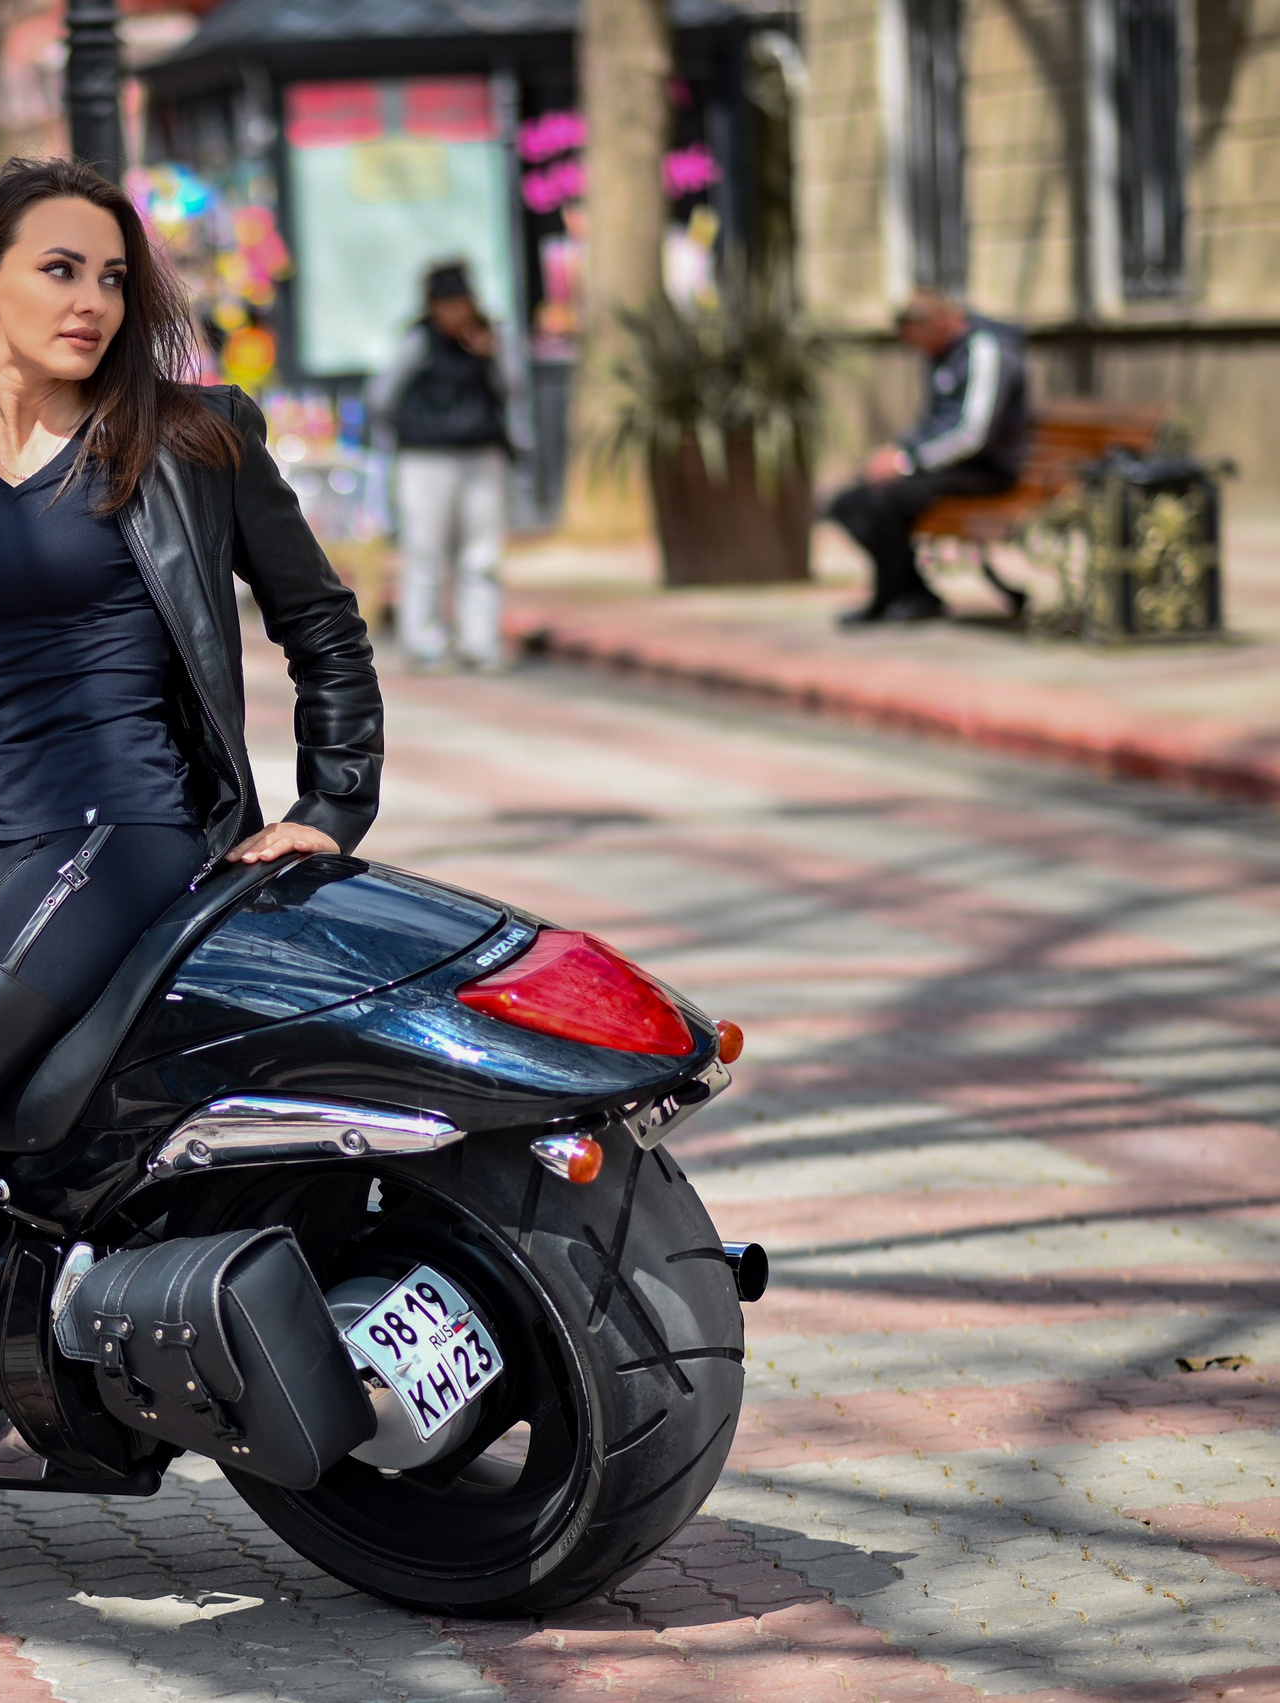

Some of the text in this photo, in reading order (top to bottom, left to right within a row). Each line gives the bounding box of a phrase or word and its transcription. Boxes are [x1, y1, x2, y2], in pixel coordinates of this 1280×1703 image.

[476, 928, 527, 967] SUZUKI
[429, 1325, 454, 1350] RUS
[453, 1330, 493, 1389] 23
